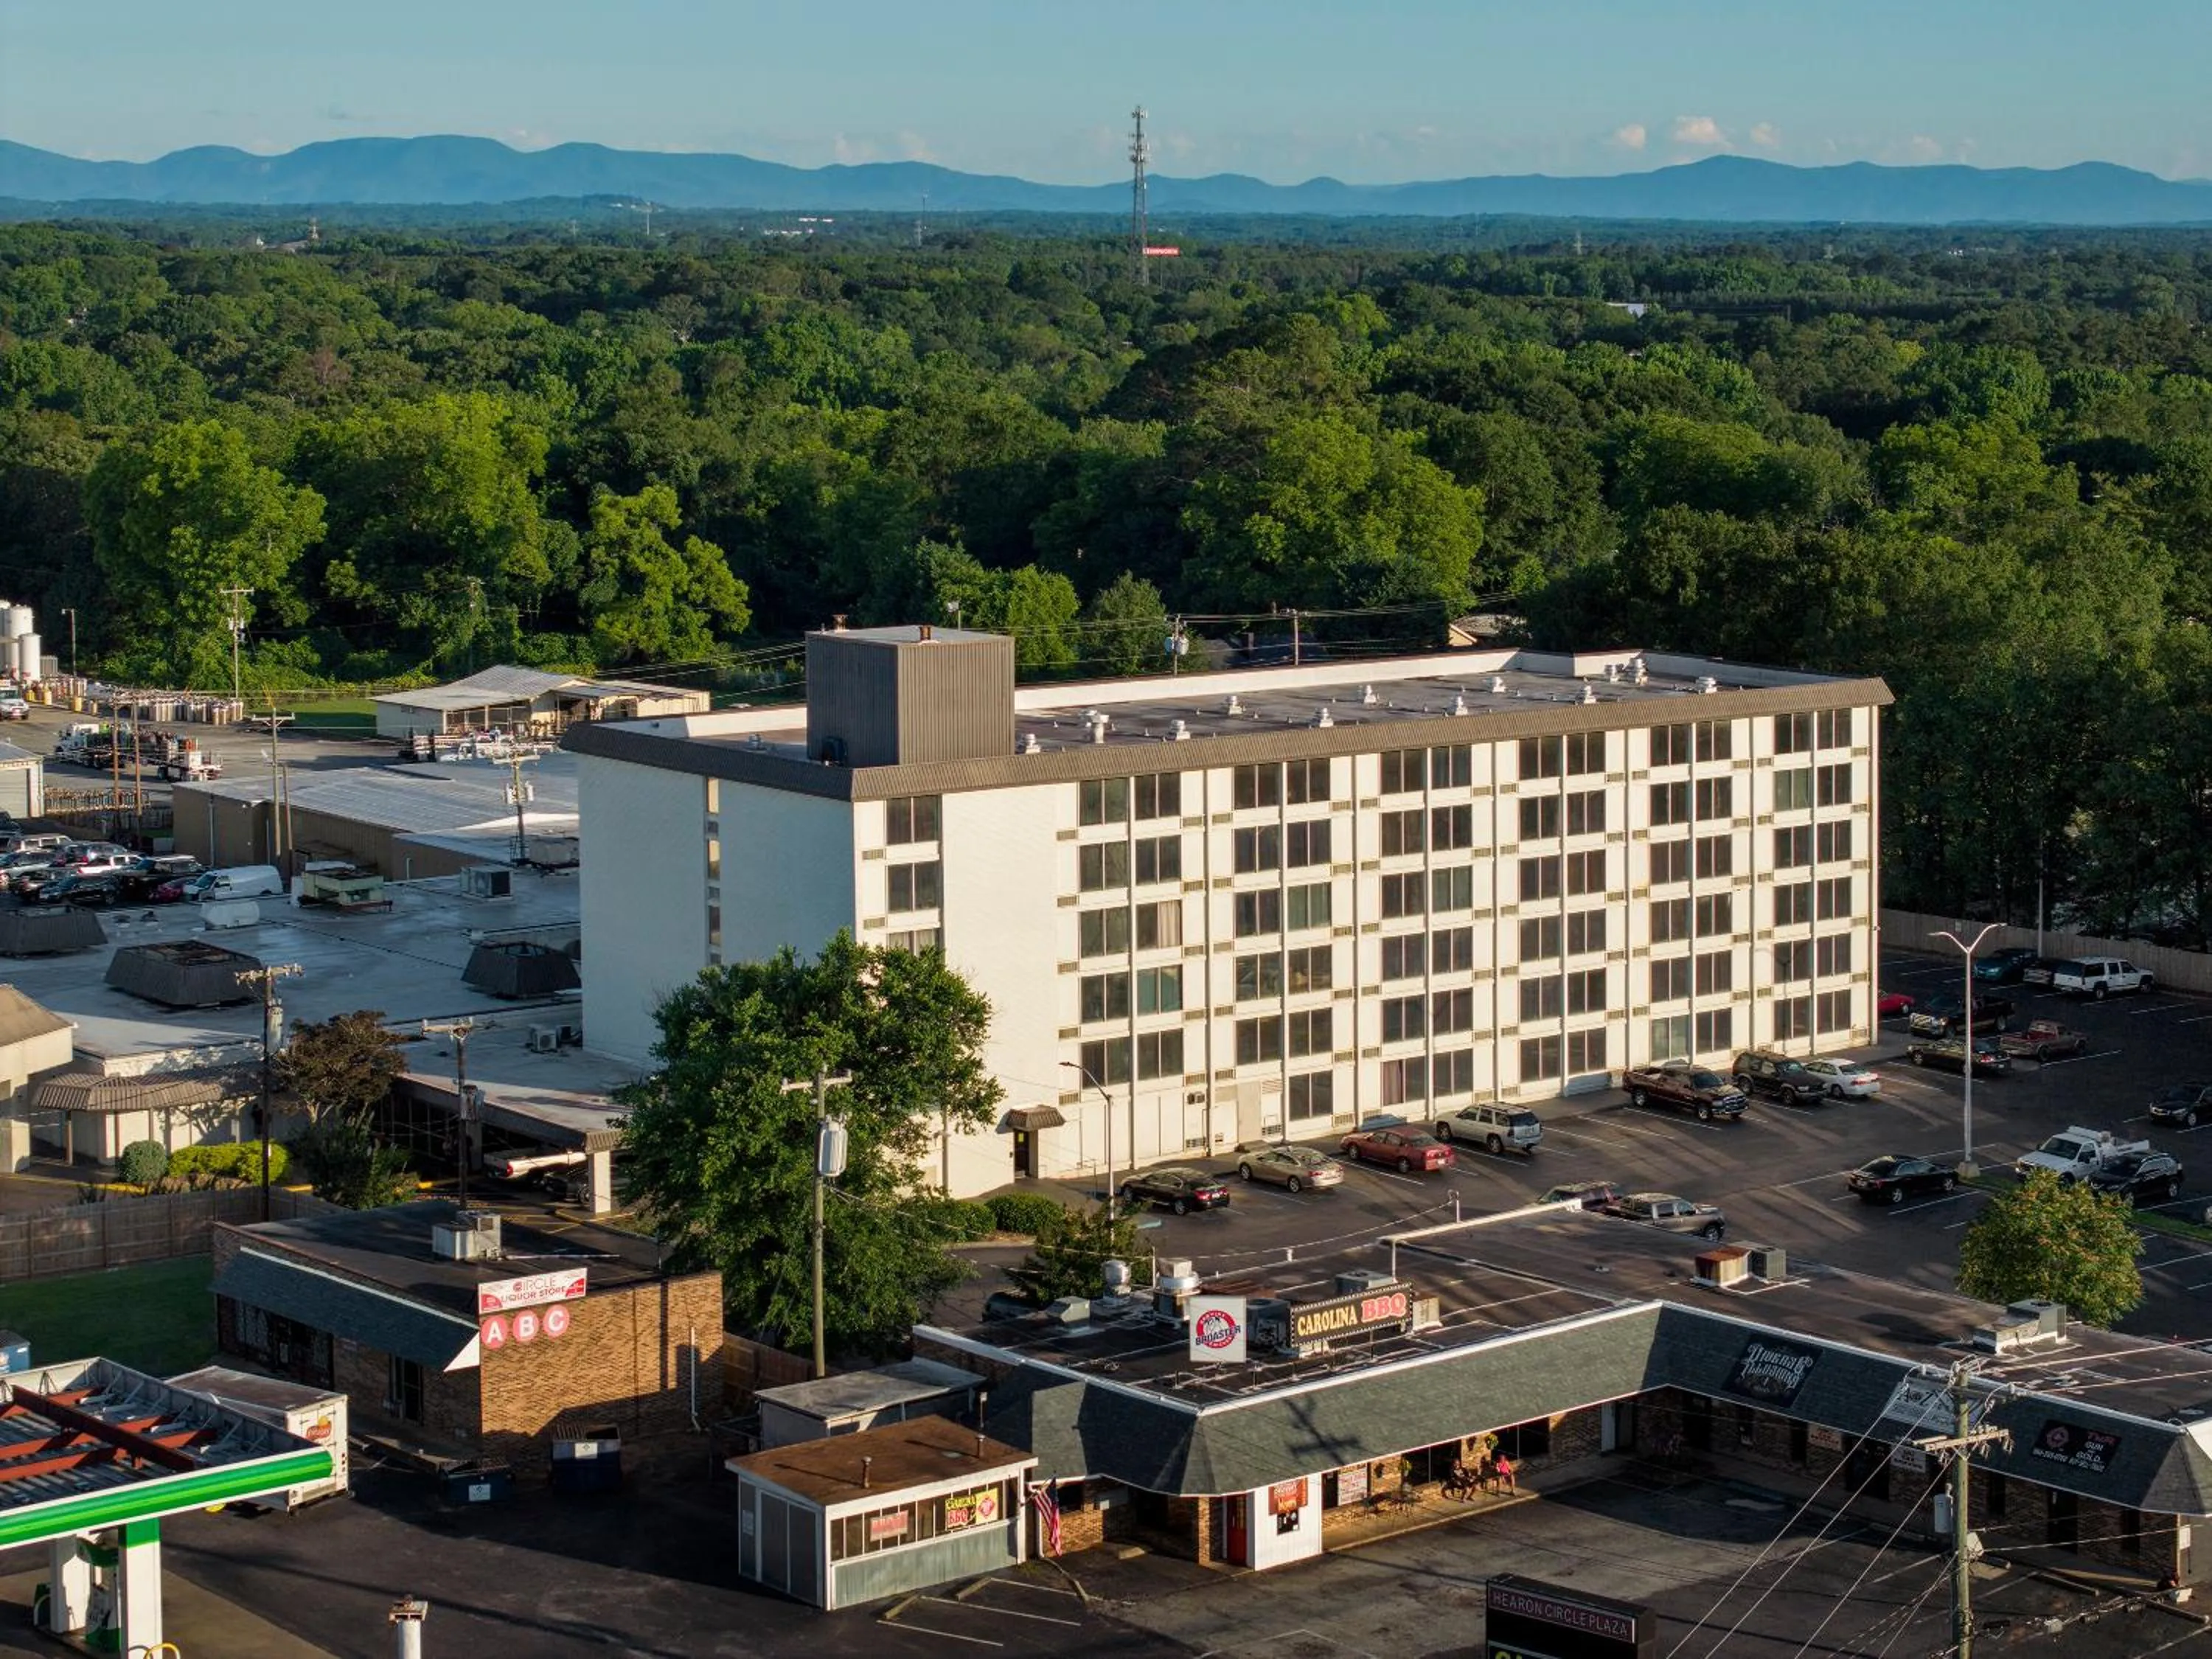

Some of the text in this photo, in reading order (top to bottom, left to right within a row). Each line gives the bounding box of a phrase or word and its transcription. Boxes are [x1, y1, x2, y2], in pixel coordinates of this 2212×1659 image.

[501, 1290, 537, 1303] LIQUOR
[539, 1285, 567, 1297] STORE
[512, 1275, 556, 1292] CIRCLE
[1297, 1293, 1407, 1336] CAROLINA BBQ
[1195, 1325, 1241, 1346] BROASTER
[1492, 1590, 1627, 1635] HEARON CIRCLE PLAZA
